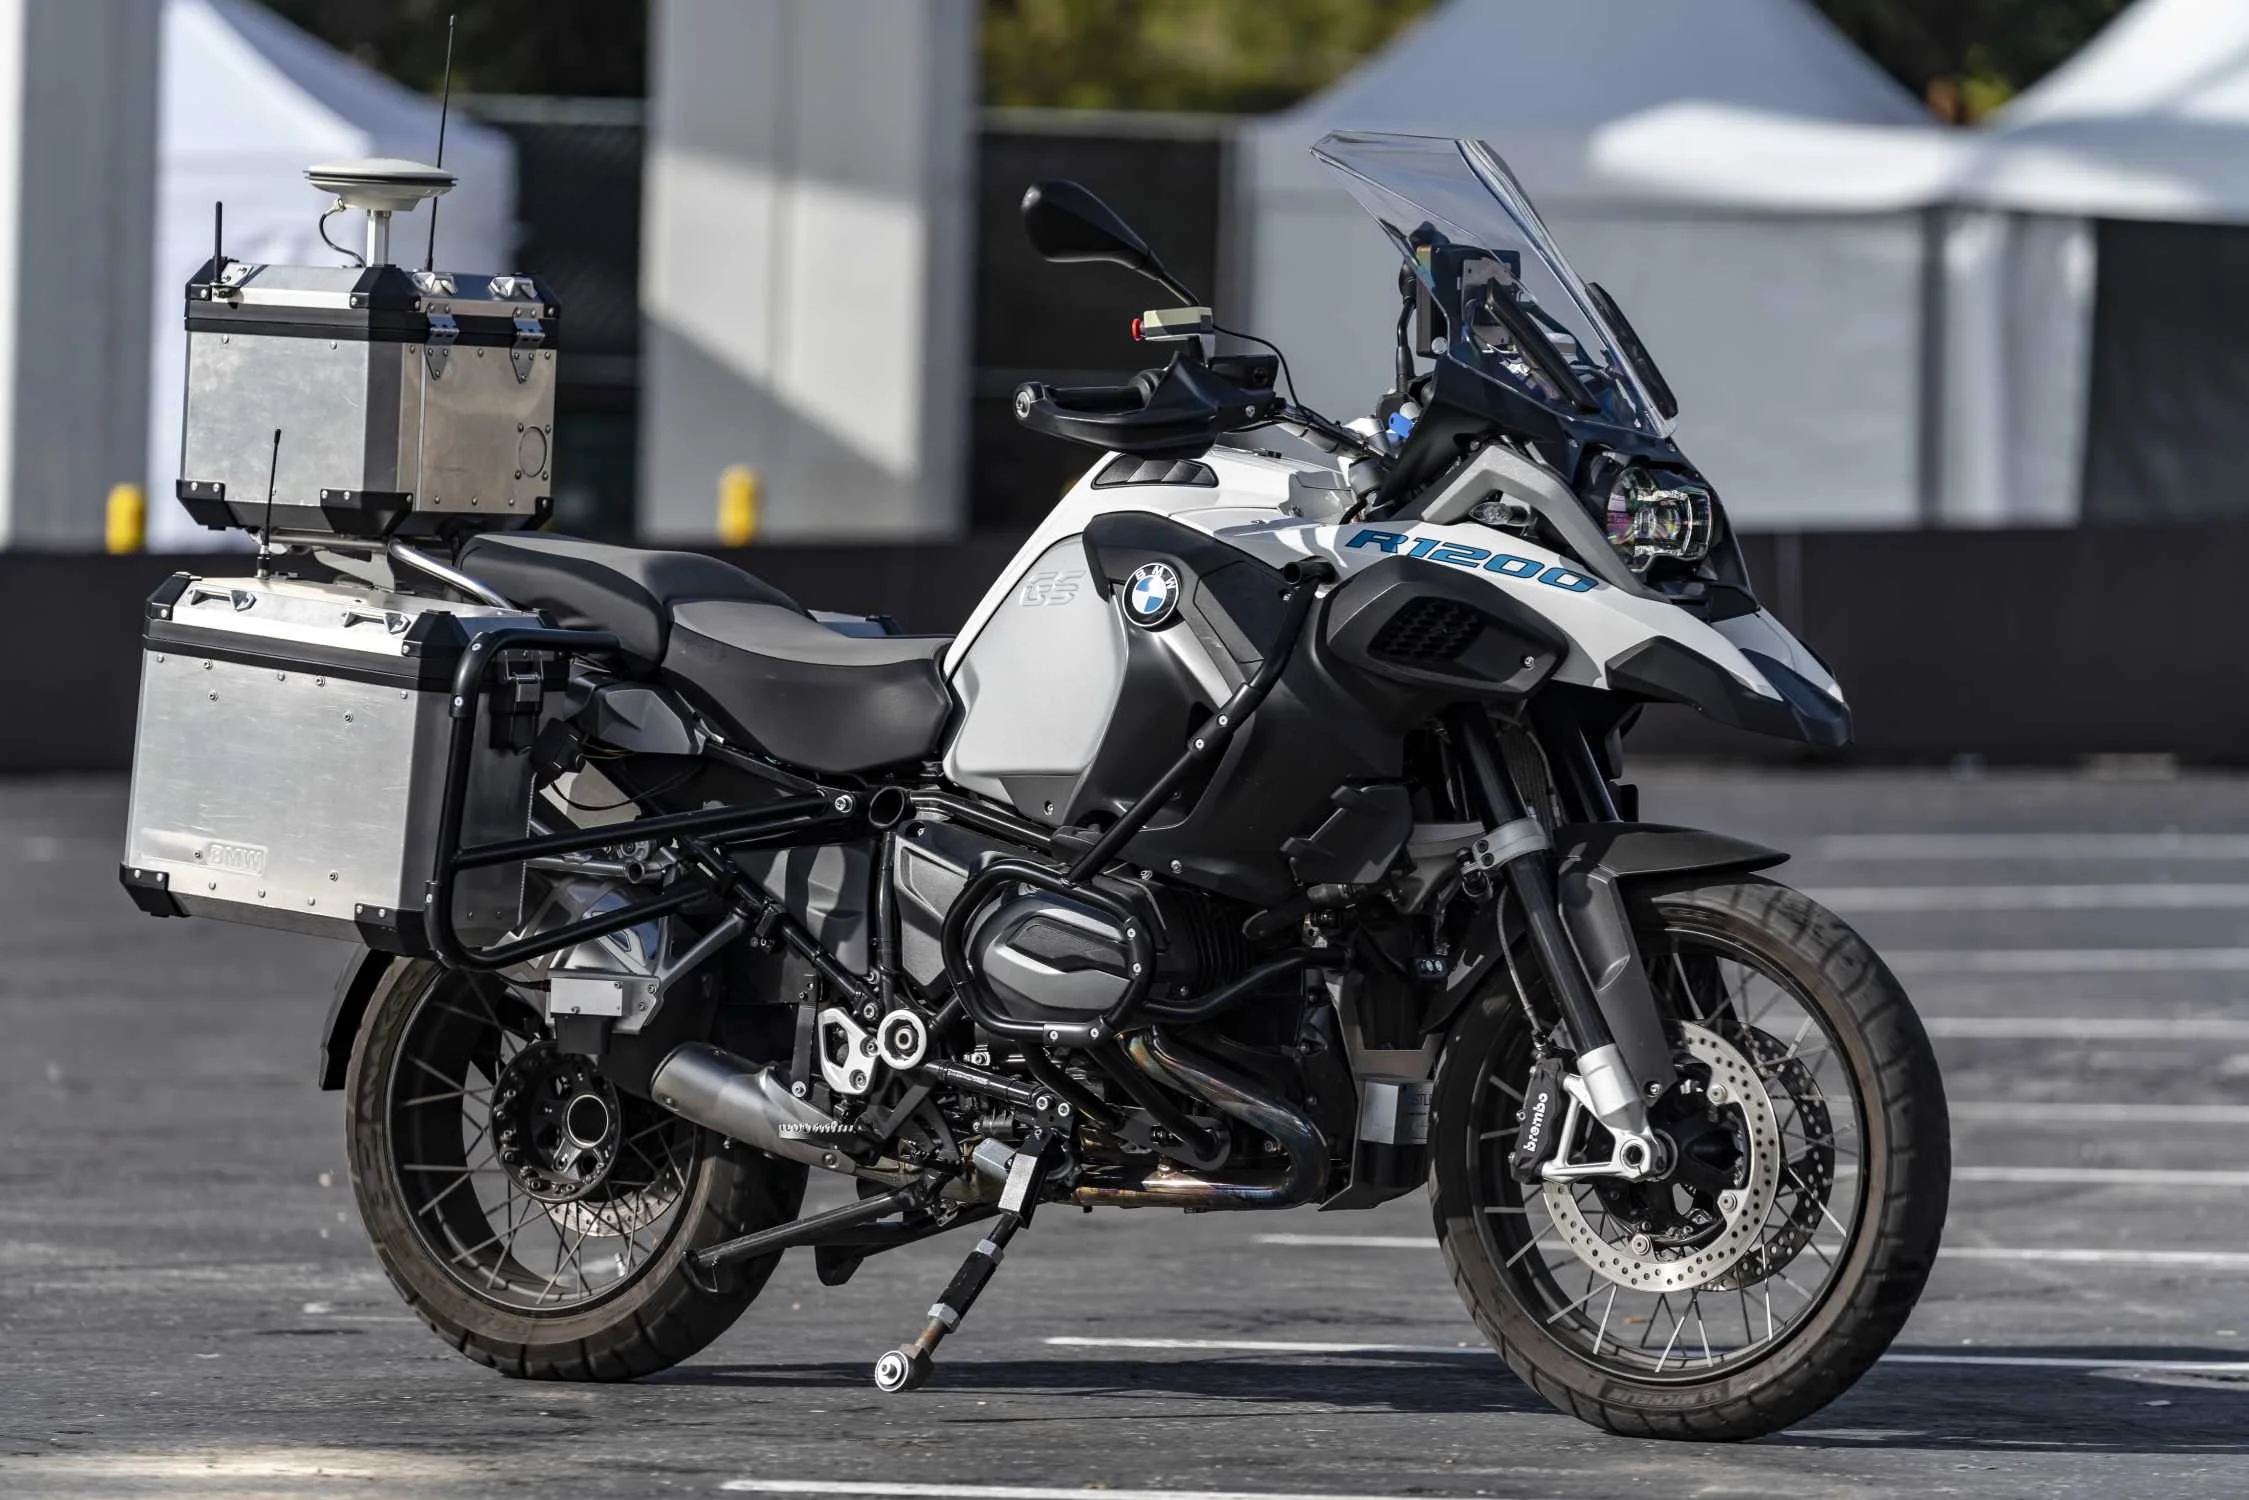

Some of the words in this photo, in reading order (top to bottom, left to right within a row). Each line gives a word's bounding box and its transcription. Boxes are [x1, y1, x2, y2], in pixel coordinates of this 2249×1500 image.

[1135, 565, 1177, 590] BMW
[1344, 529, 1600, 593] R1200
[1019, 570, 1087, 607] GS
[209, 844, 264, 874] BMW
[1523, 1092, 1548, 1152] brembo
